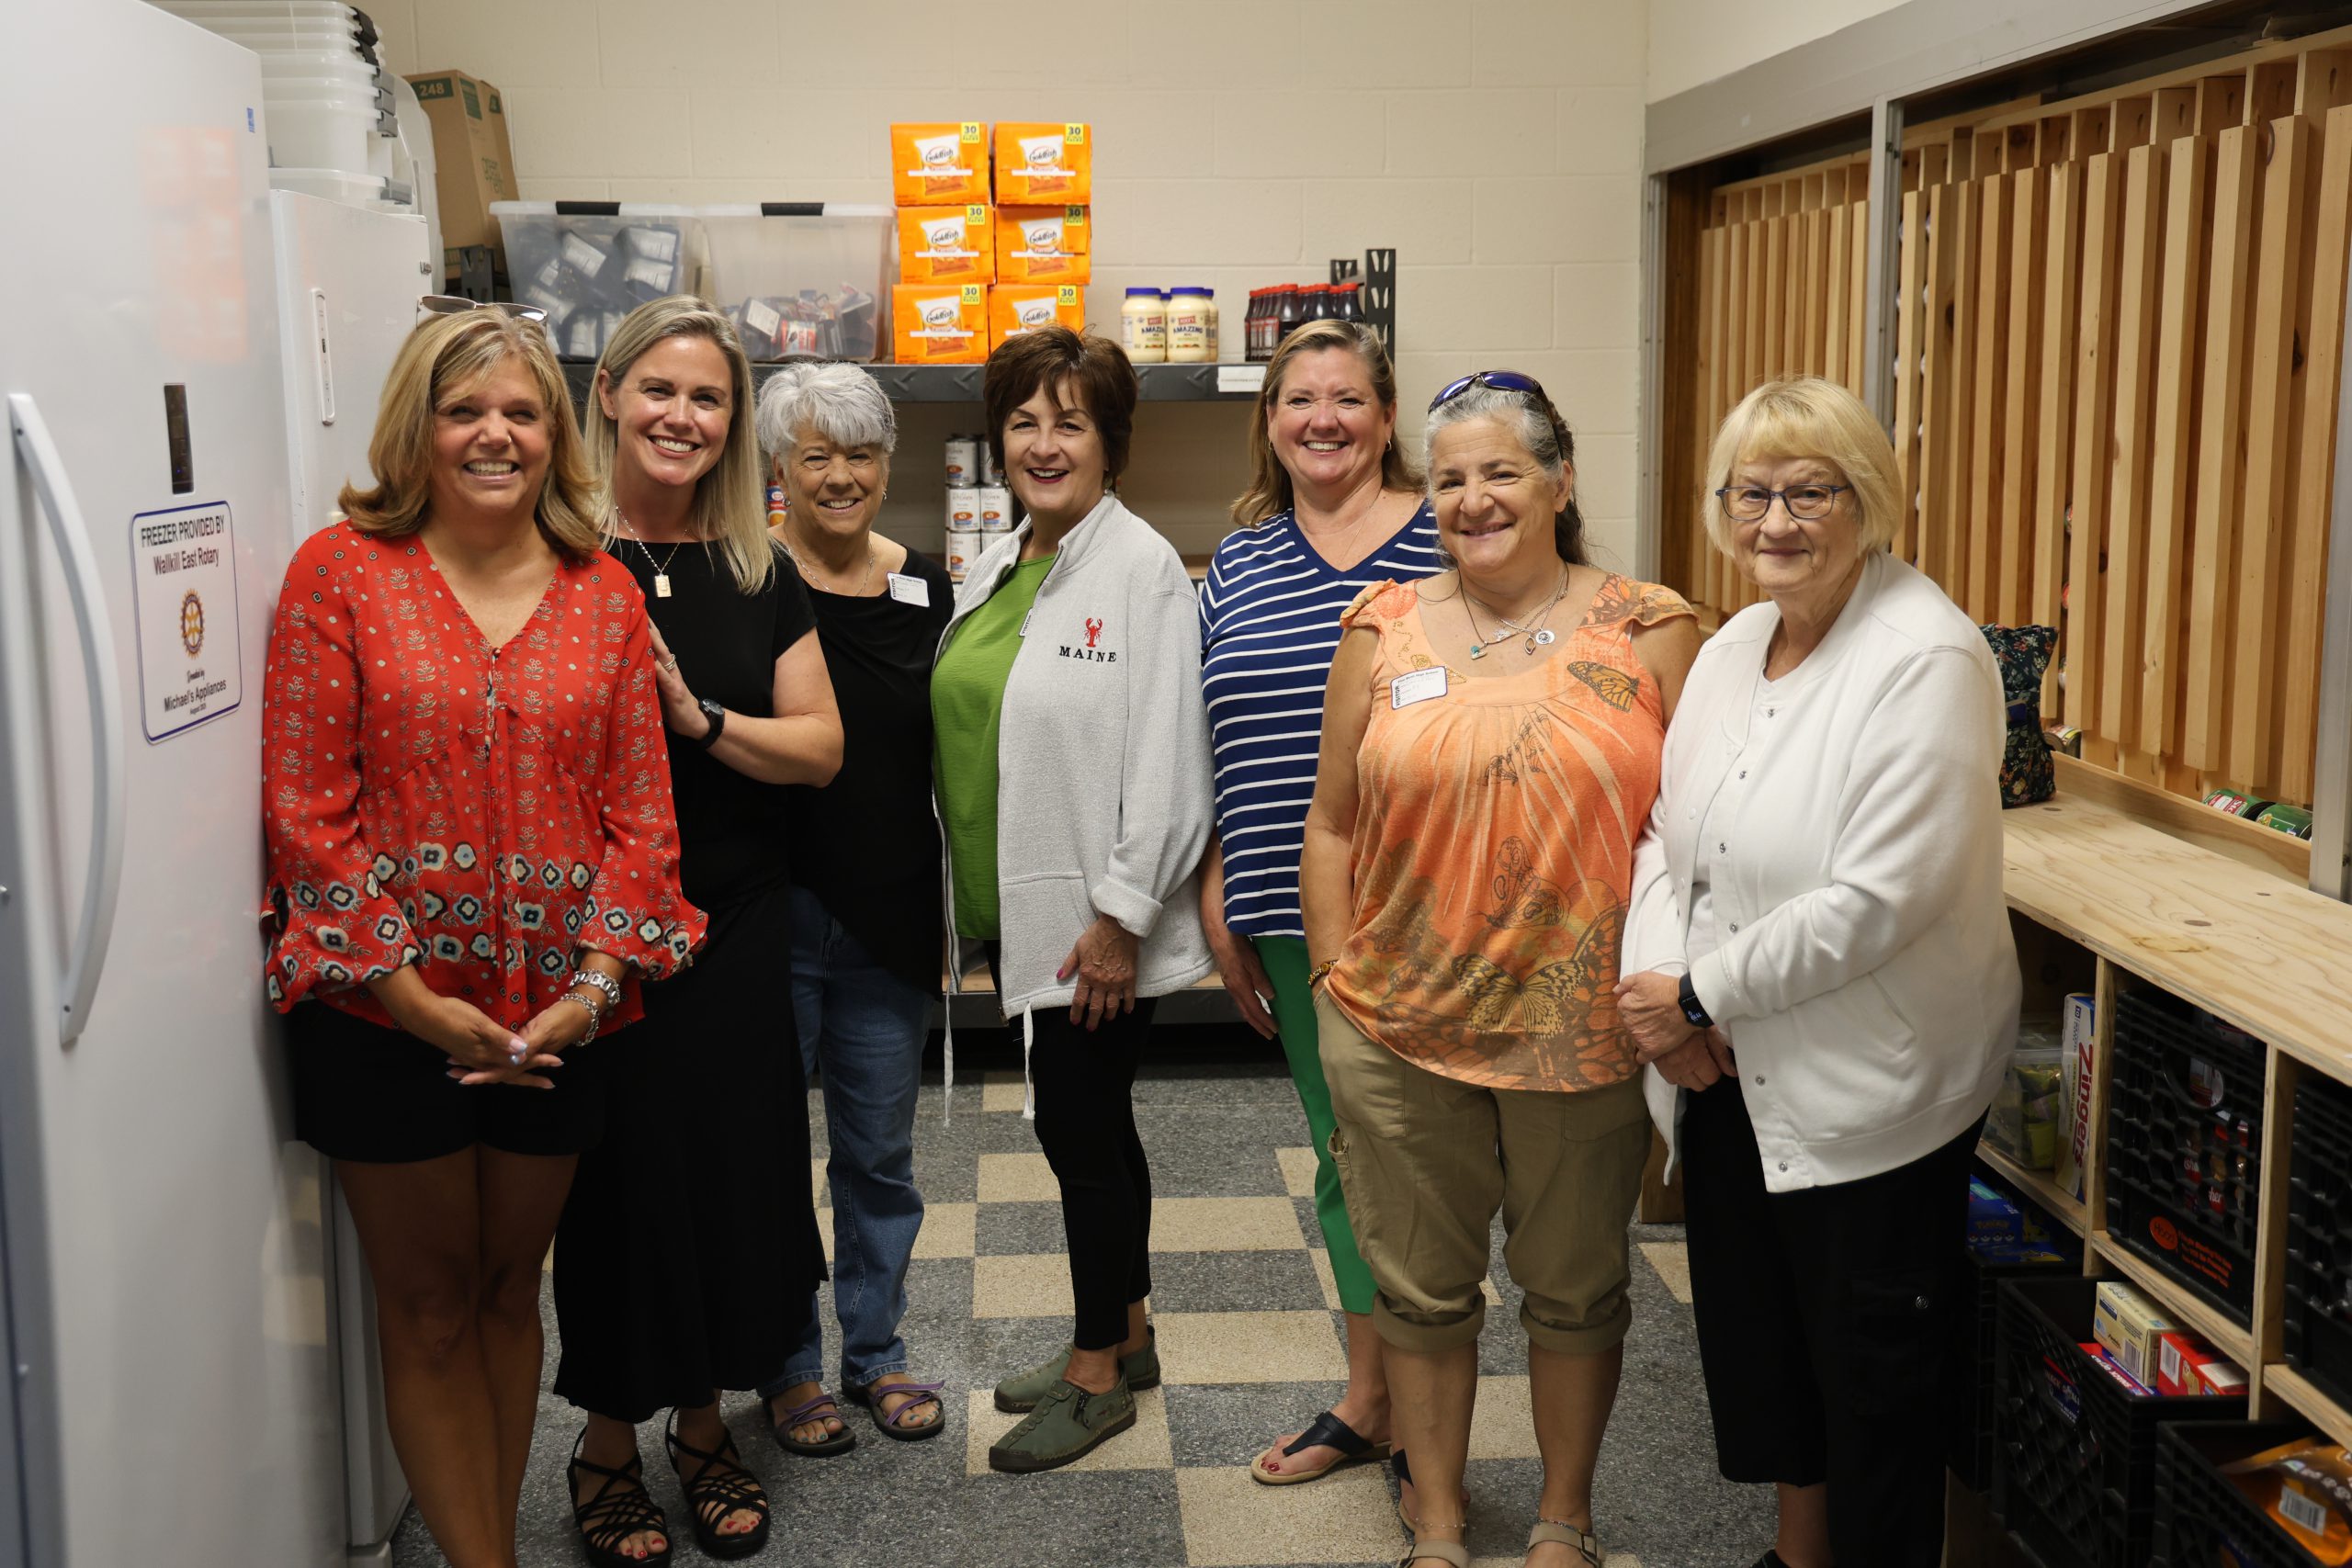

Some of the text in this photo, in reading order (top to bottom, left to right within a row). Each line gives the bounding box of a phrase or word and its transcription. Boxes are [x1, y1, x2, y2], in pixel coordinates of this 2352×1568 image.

[419, 83, 445, 96] 248
[964, 126, 977, 135] 30
[1068, 126, 1081, 136] 30
[925, 148, 954, 164] Goldfish
[1028, 149, 1057, 164] Goldfish
[969, 208, 982, 217] 30
[1068, 208, 1081, 218] 30
[931, 230, 959, 245] Goldfish
[1029, 230, 1057, 245] Goldfish
[965, 288, 978, 297] 30
[1061, 288, 1074, 298] 30
[925, 309, 954, 324] Goldfish
[1022, 310, 1051, 325] Goldfish
[1173, 325, 1204, 334] AMAZING
[141, 514, 225, 547] FREEZER PROVIDED BY
[153, 547, 220, 575] Wallkill East Rotary
[1058, 645, 1117, 662] MAINE
[164, 680, 227, 713] Michael's Appliances
[2073, 1042, 2094, 1168] Zingers
